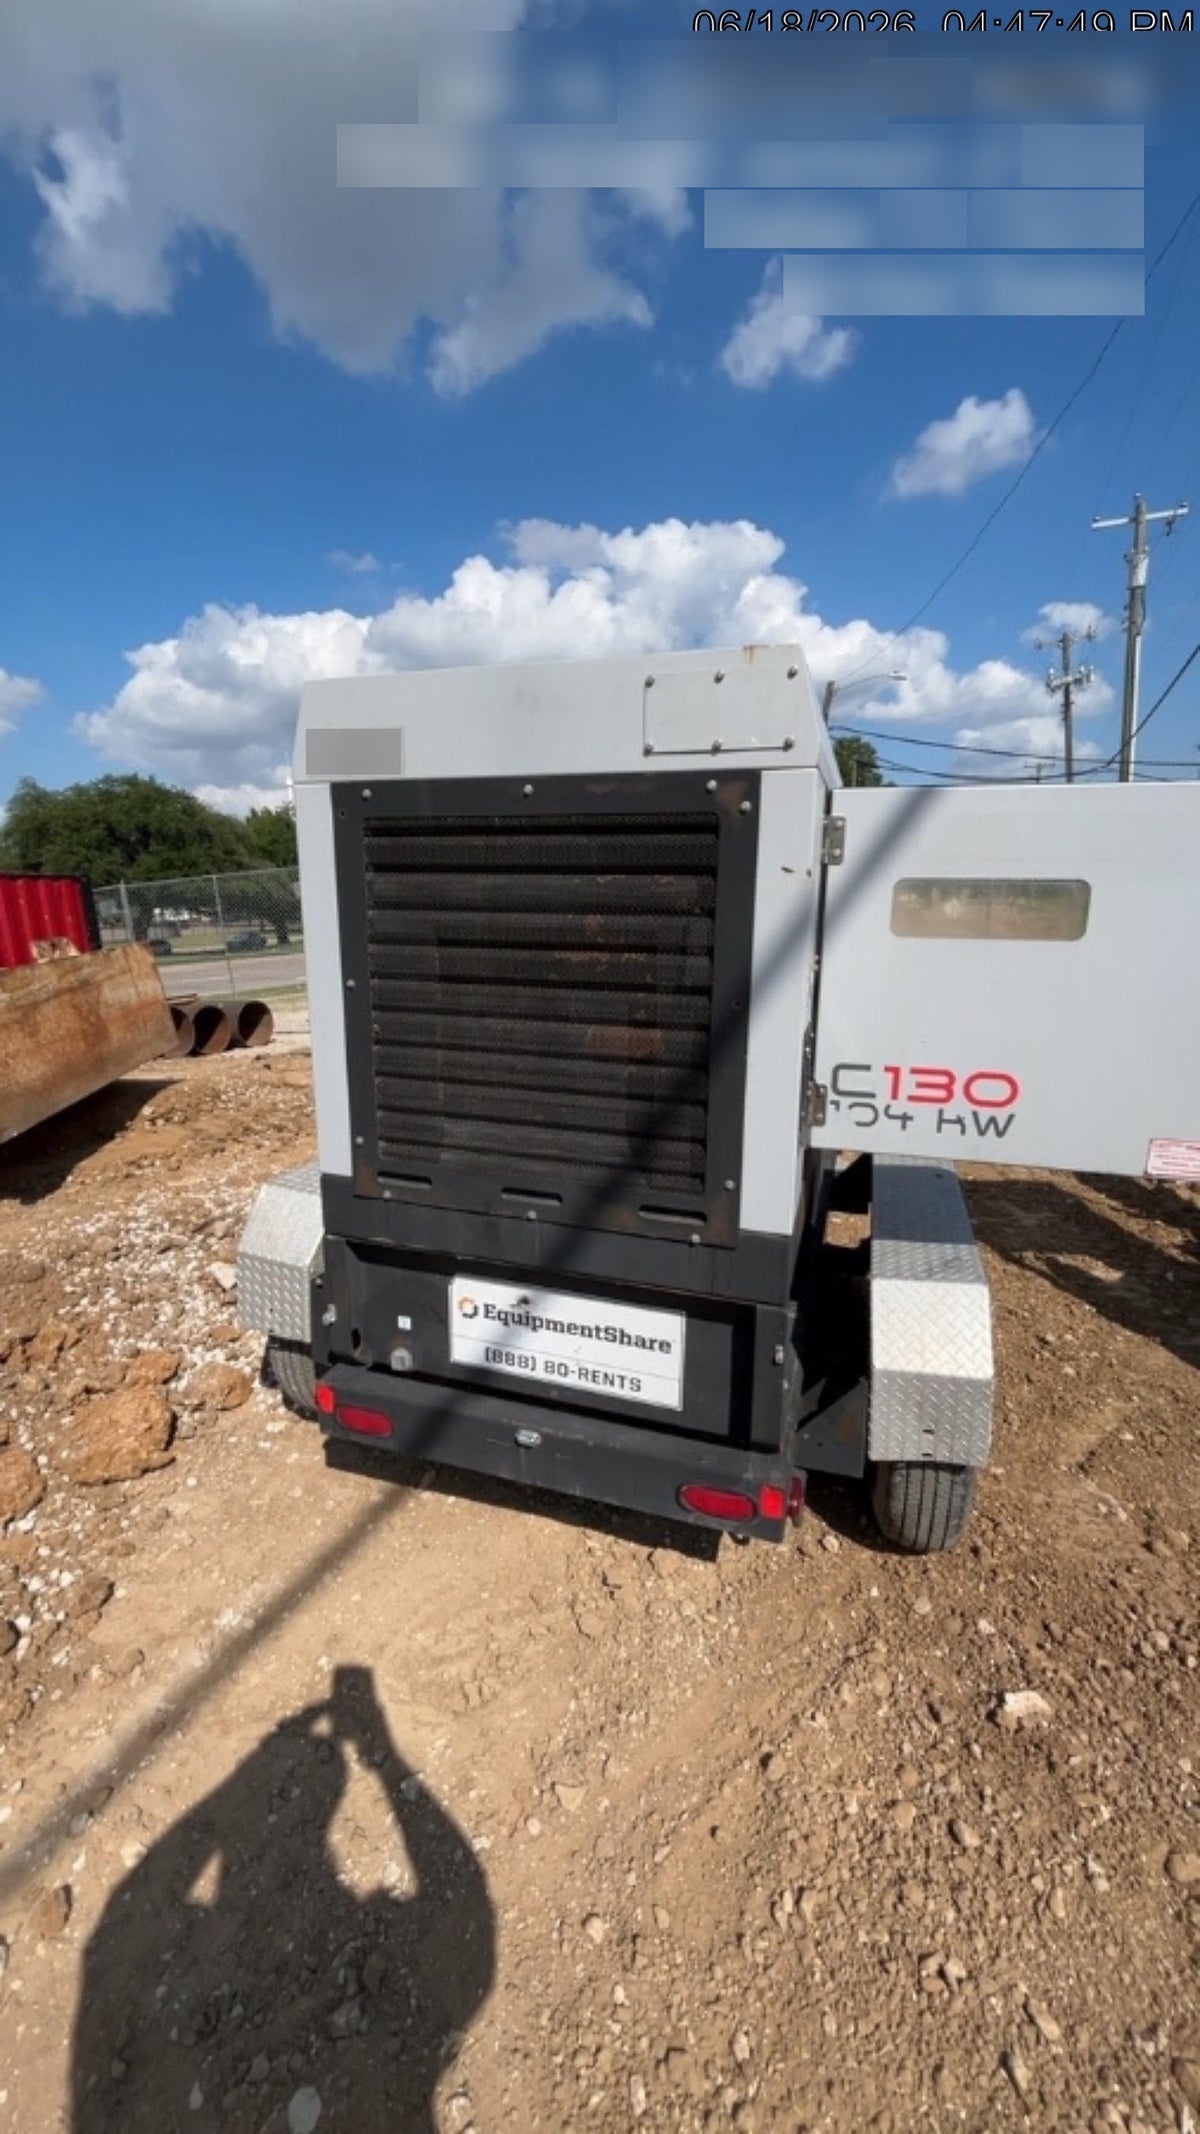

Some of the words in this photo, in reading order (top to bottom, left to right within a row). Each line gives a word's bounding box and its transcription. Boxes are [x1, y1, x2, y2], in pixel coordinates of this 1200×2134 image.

[483, 1303, 672, 1354] EquipmentShare
[485, 1346, 537, 1371] (888)
[544, 1360, 642, 1392] 80-RENTS
